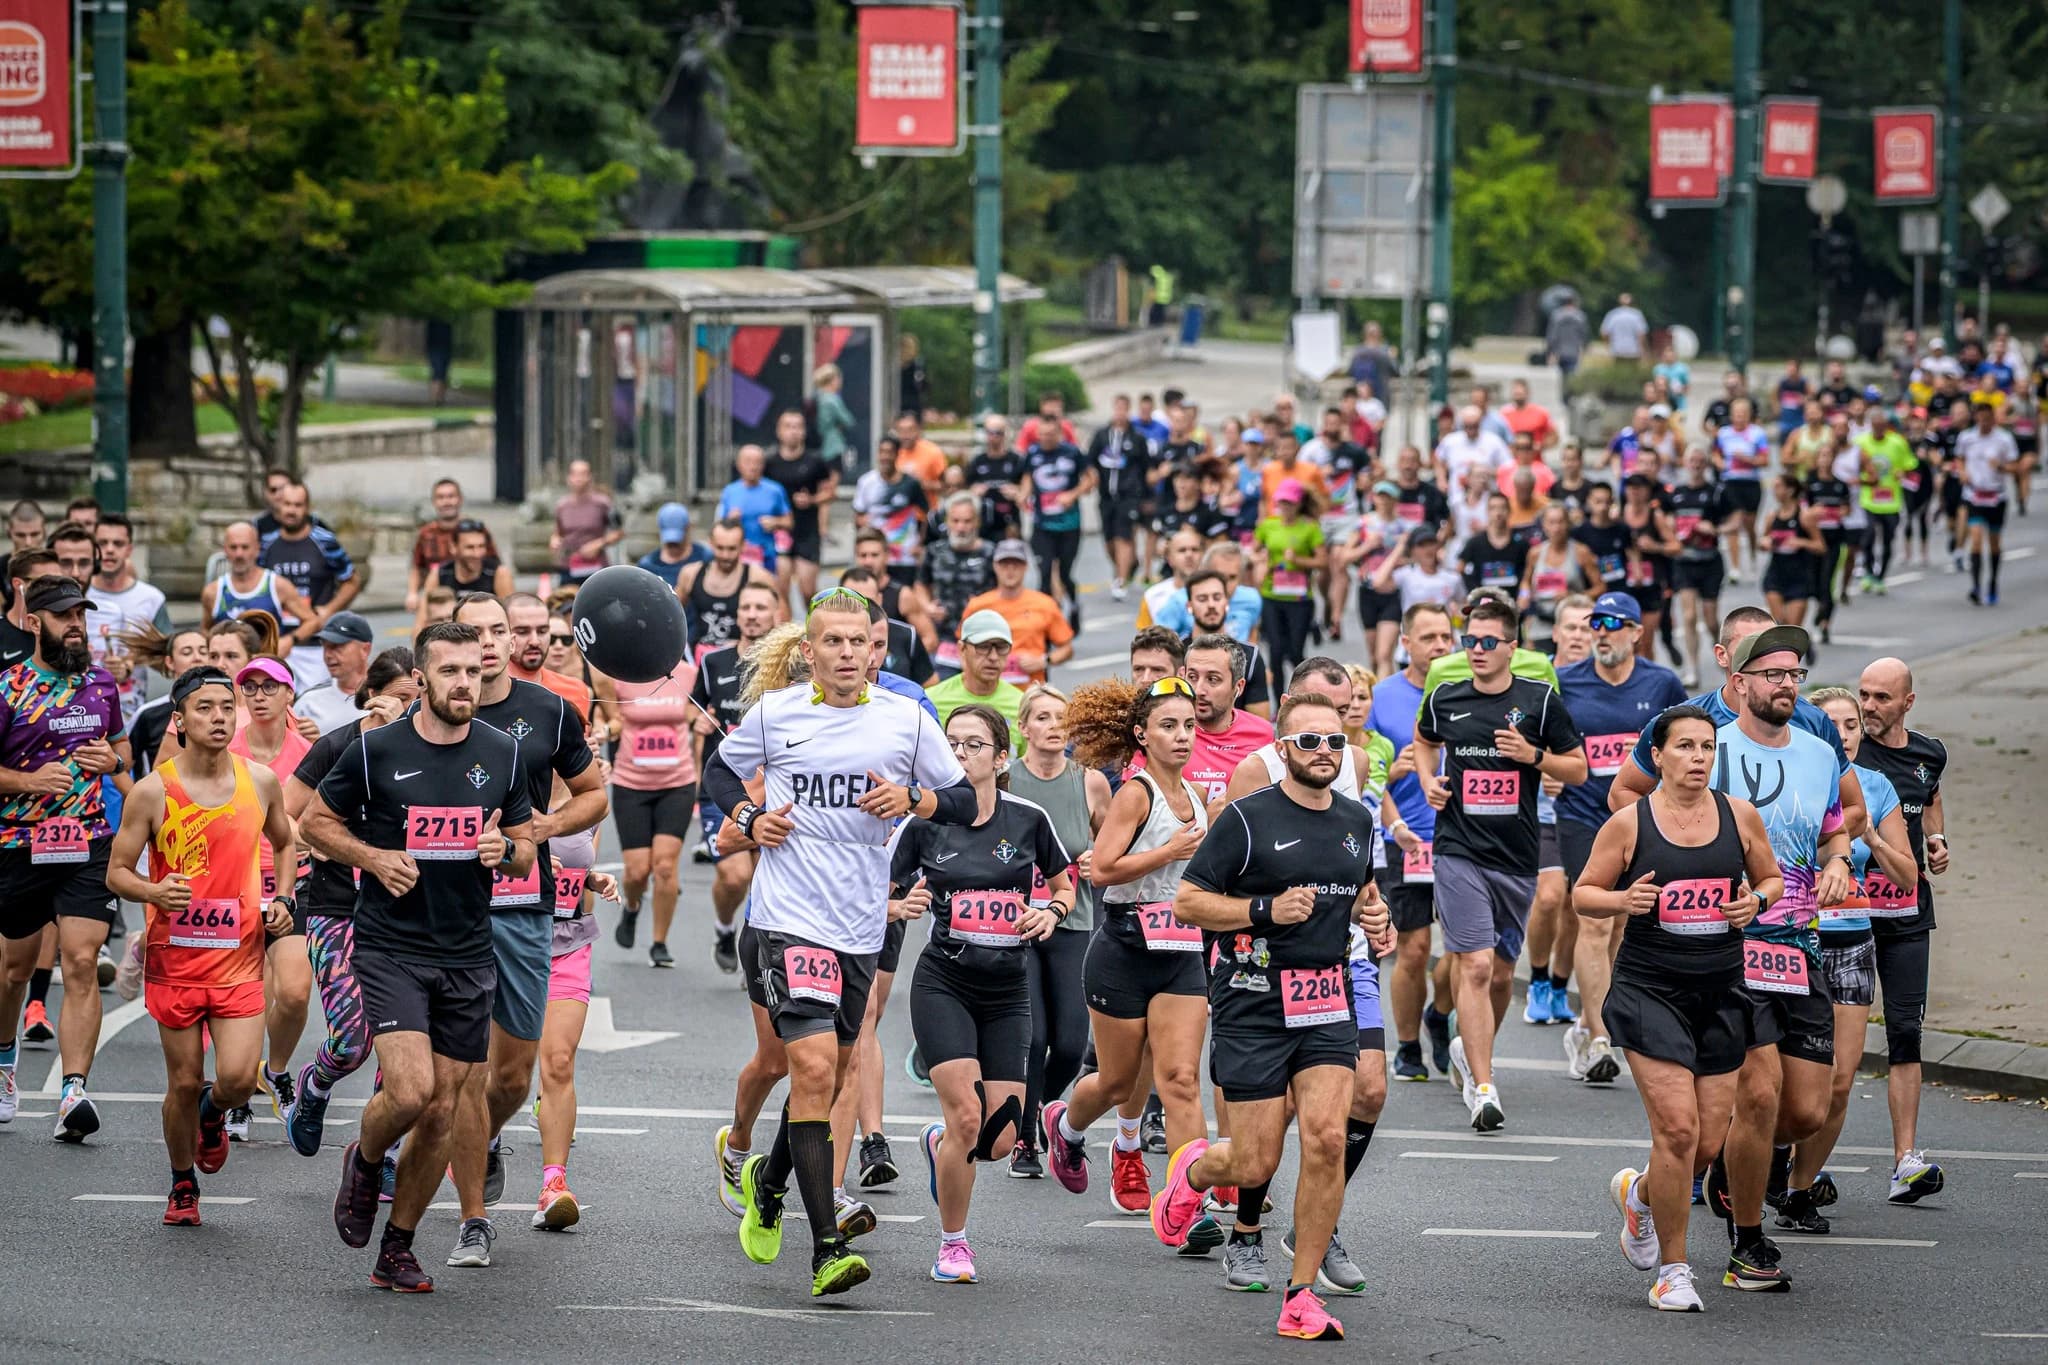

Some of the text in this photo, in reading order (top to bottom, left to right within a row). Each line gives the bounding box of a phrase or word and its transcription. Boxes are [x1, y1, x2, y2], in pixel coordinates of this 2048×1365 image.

[0, 67, 39, 84] ING
[637, 737, 675, 750] 2884
[1591, 742, 1624, 759] 249
[1468, 778, 1515, 795] 2323
[37, 825, 83, 843] 2372
[415, 817, 477, 837] 2715
[1330, 883, 1358, 896] Bank
[1666, 888, 1724, 911] 2262
[176, 908, 234, 928] 2664
[958, 899, 1018, 923] 2190
[793, 955, 840, 982] 2629
[1747, 950, 1801, 974] 2885
[1290, 977, 1340, 1001] 2284
